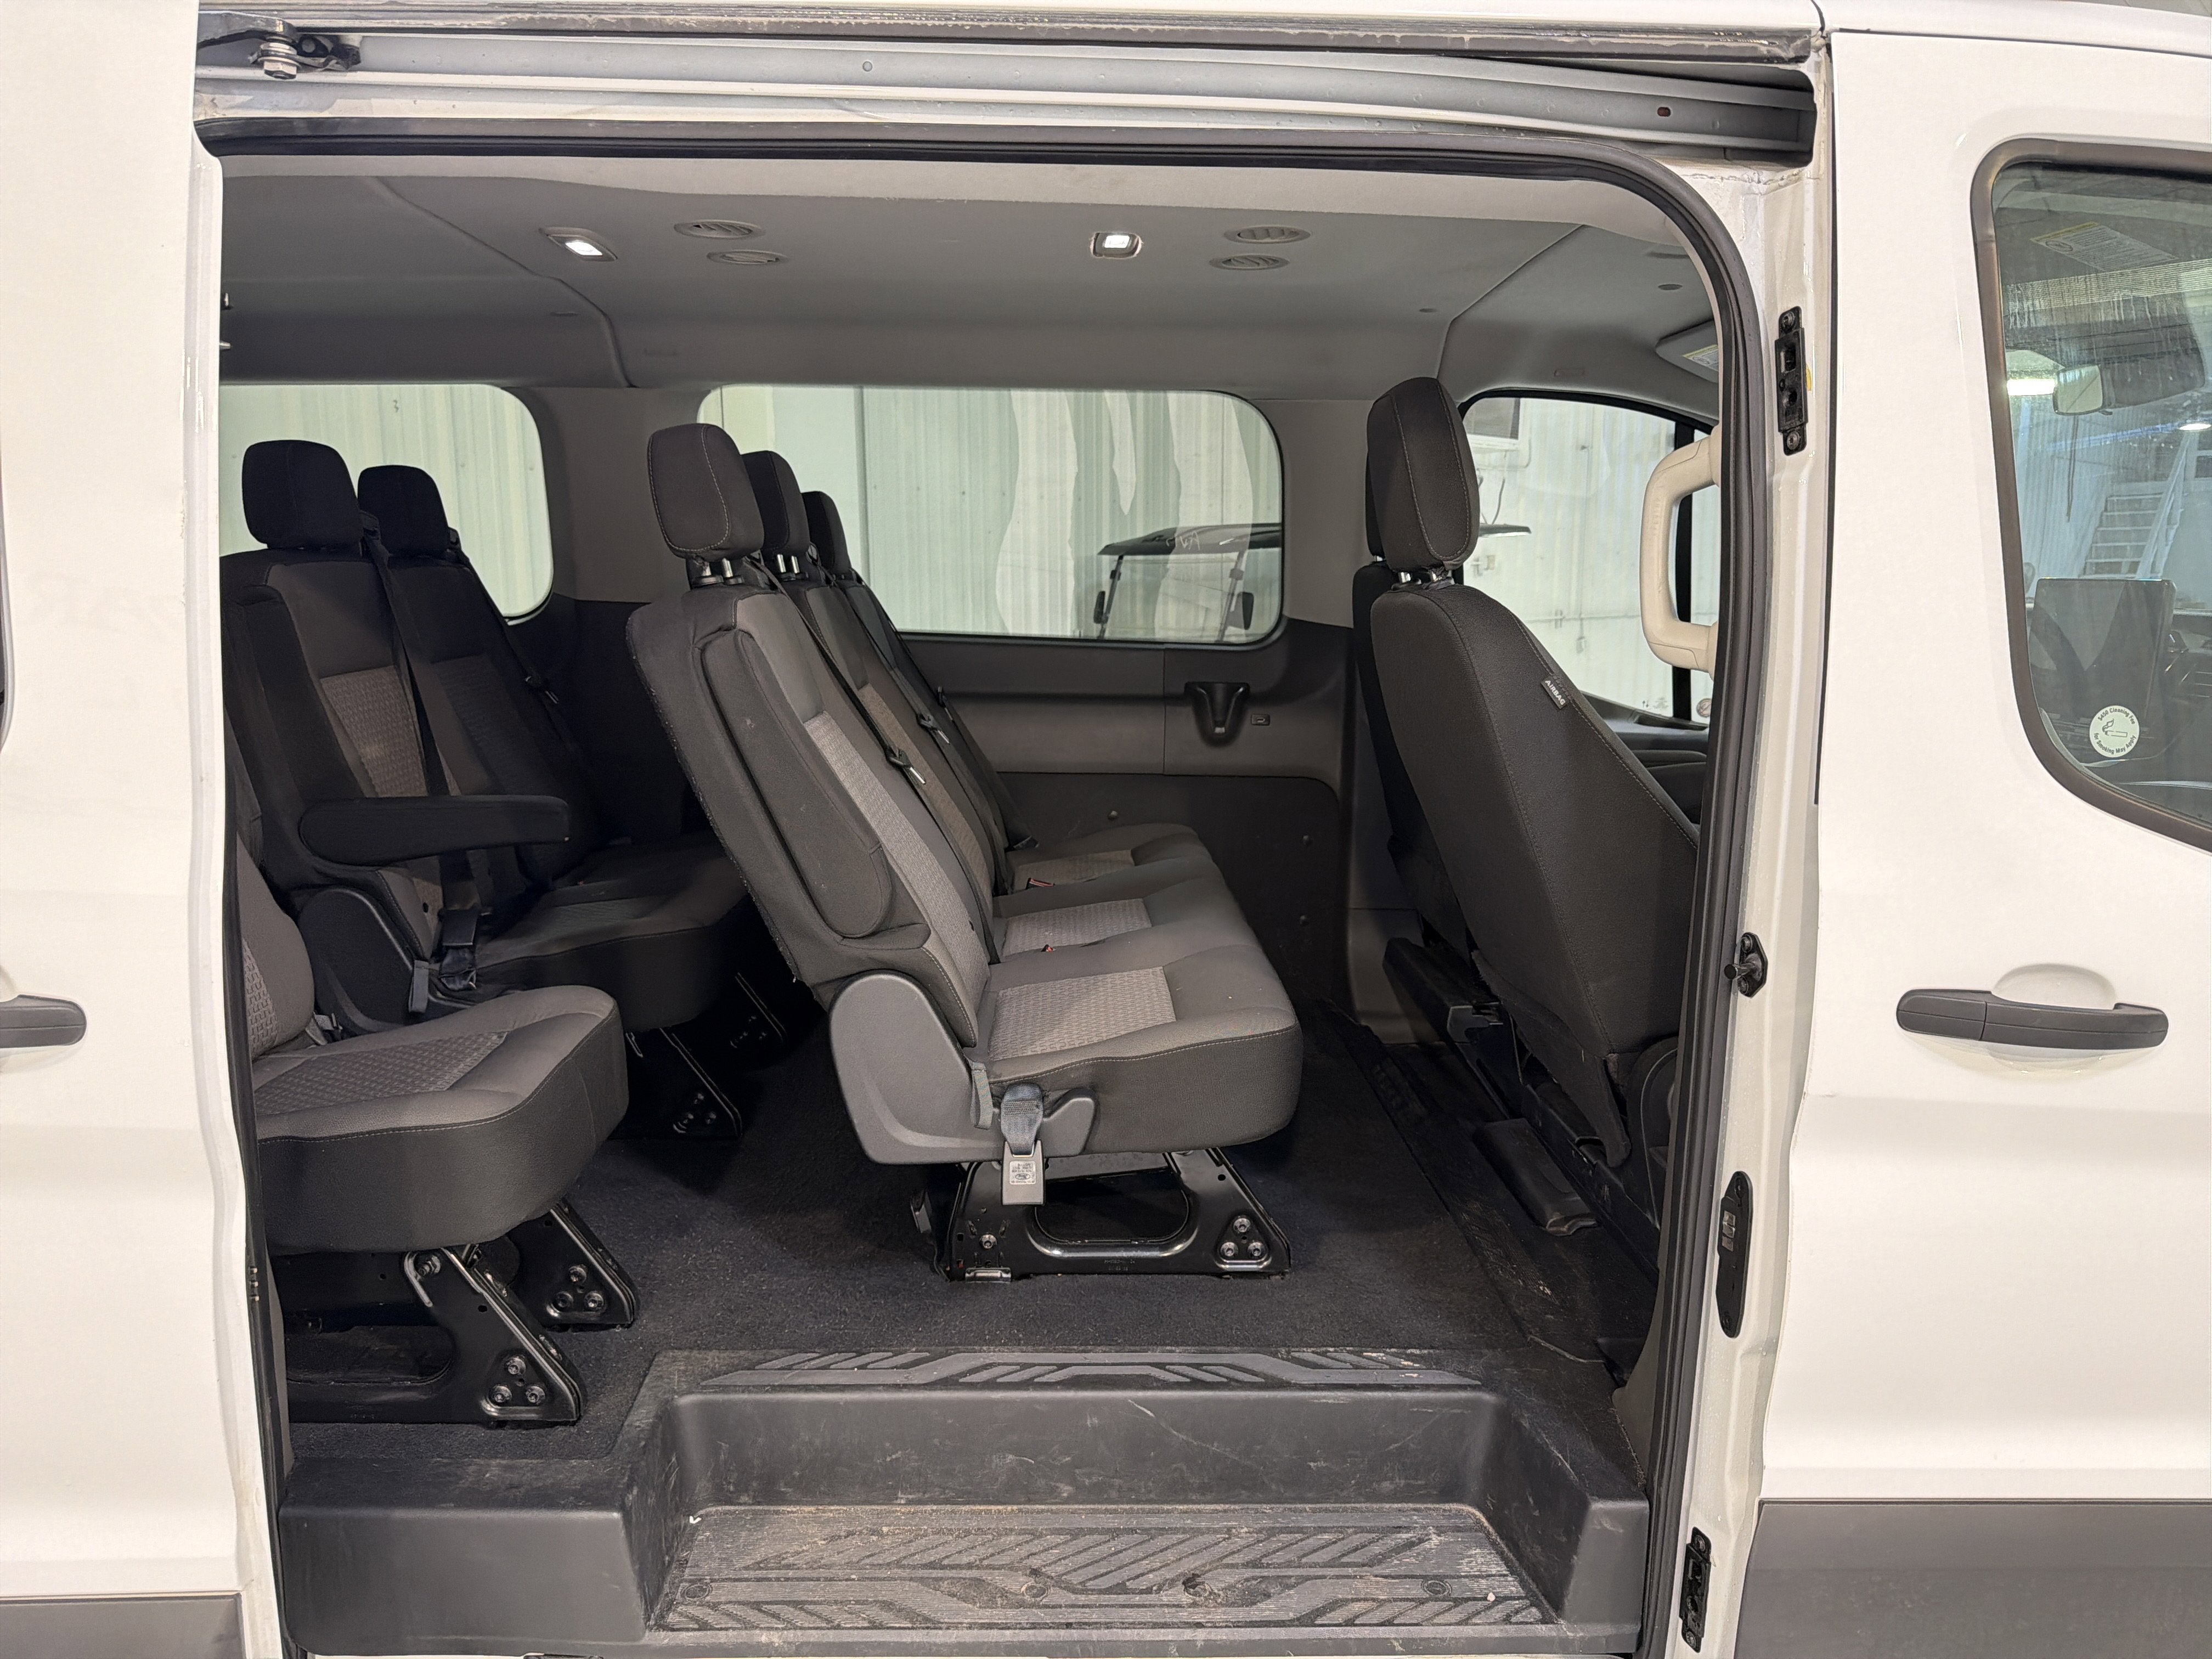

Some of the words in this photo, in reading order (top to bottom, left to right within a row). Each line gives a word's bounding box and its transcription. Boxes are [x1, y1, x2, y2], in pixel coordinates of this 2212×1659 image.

[1545, 680, 1566, 705] AIRBAG
[2097, 710, 2109, 721] $450
[2109, 708, 2130, 718] Cleaning
[2096, 740, 2114, 755] Smoking
[2125, 735, 2137, 749] Apply
